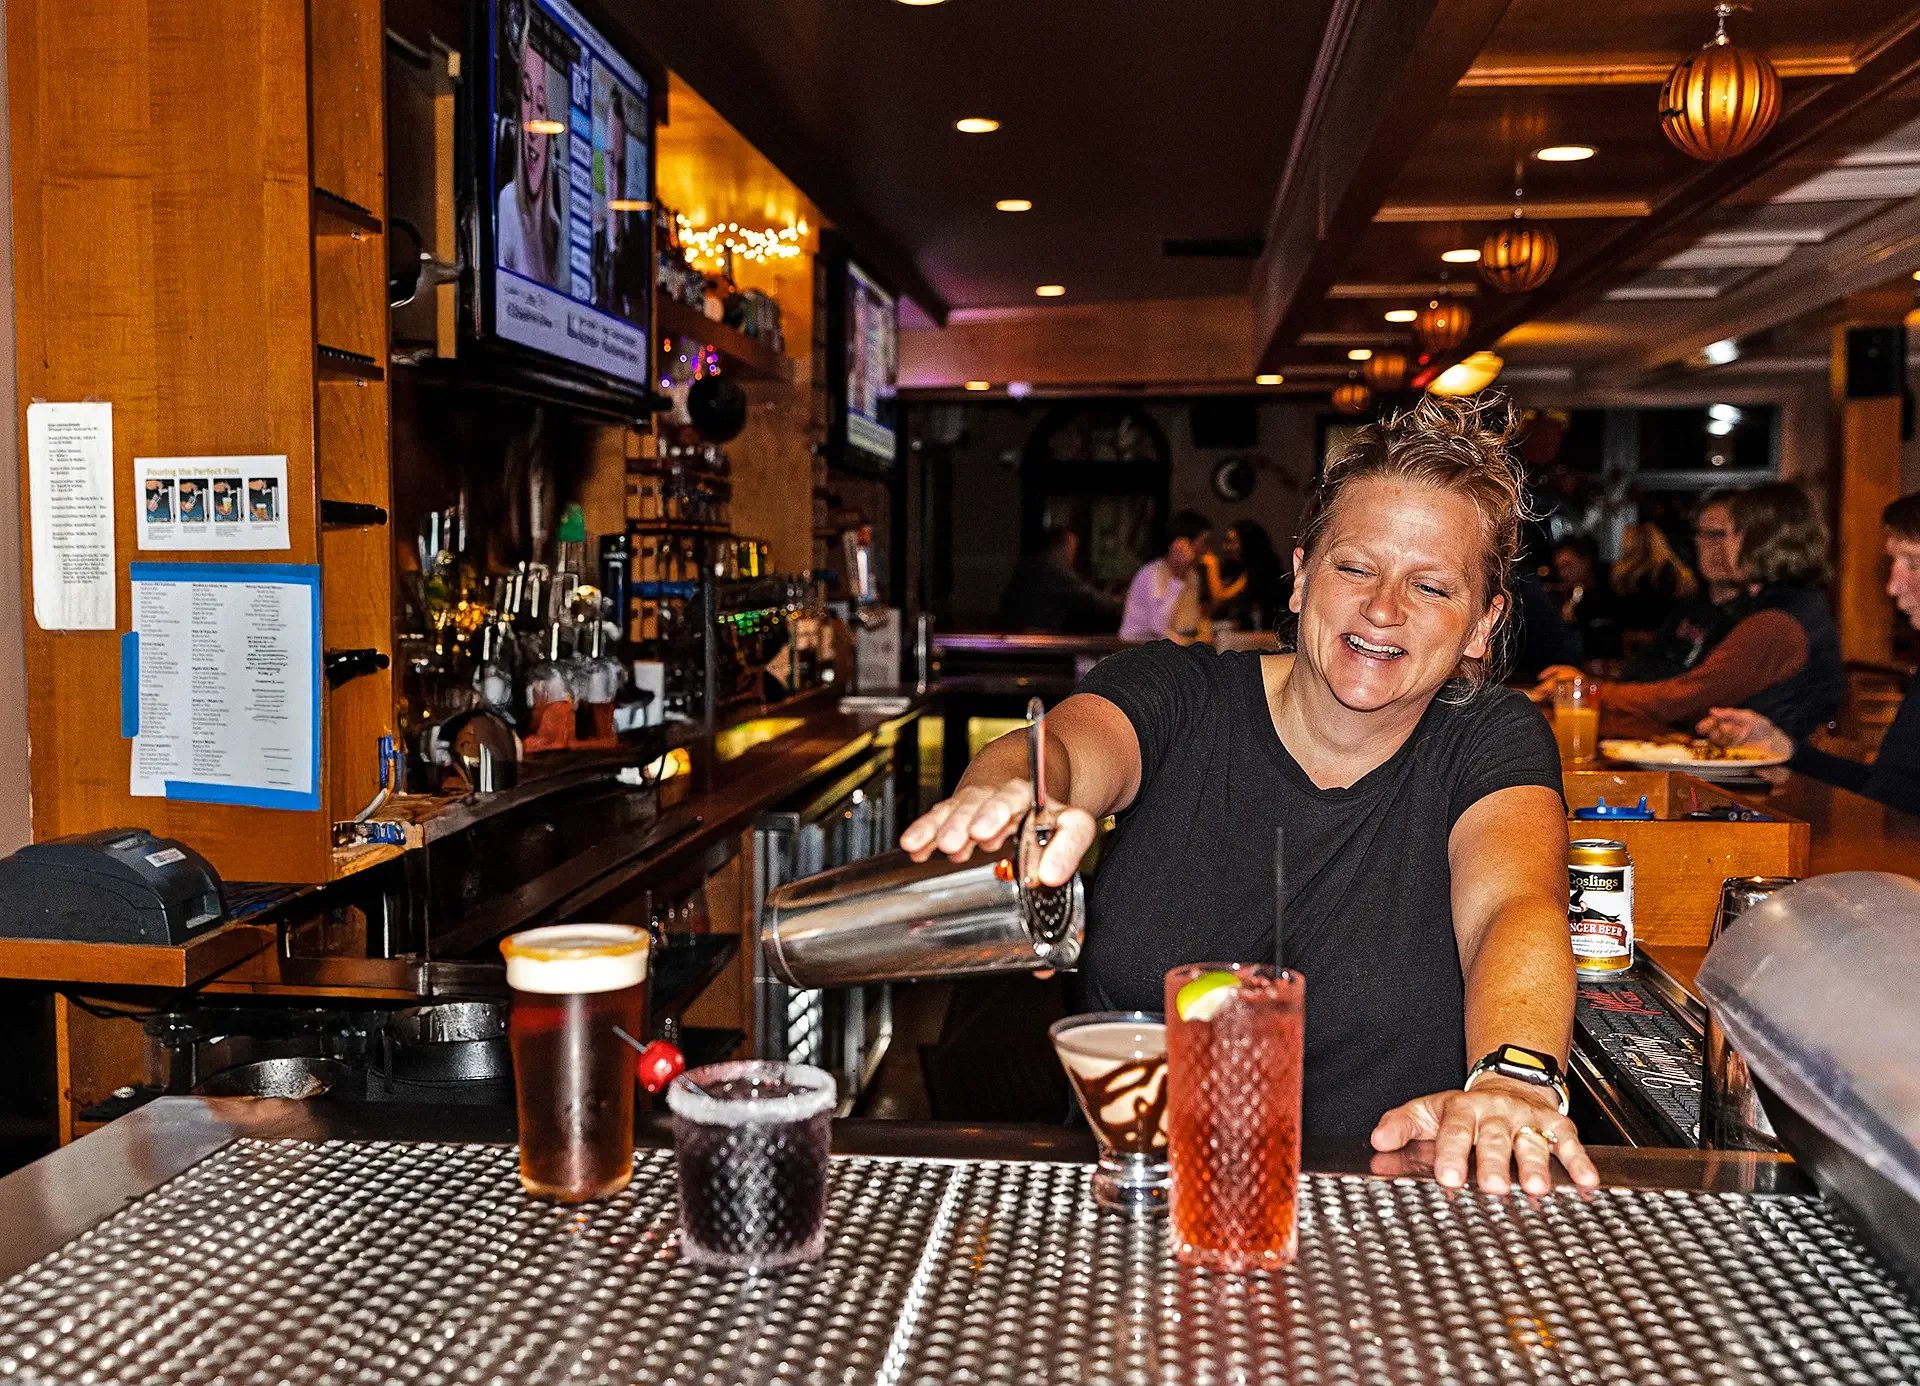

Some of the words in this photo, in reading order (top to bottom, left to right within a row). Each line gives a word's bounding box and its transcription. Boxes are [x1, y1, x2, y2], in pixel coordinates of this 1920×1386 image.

[146, 467, 176, 477] Pouring
[178, 467, 192, 475] the
[193, 466, 222, 475] Perfect
[1569, 922, 1597, 934] NGER
[1598, 924, 1623, 937] BEER
